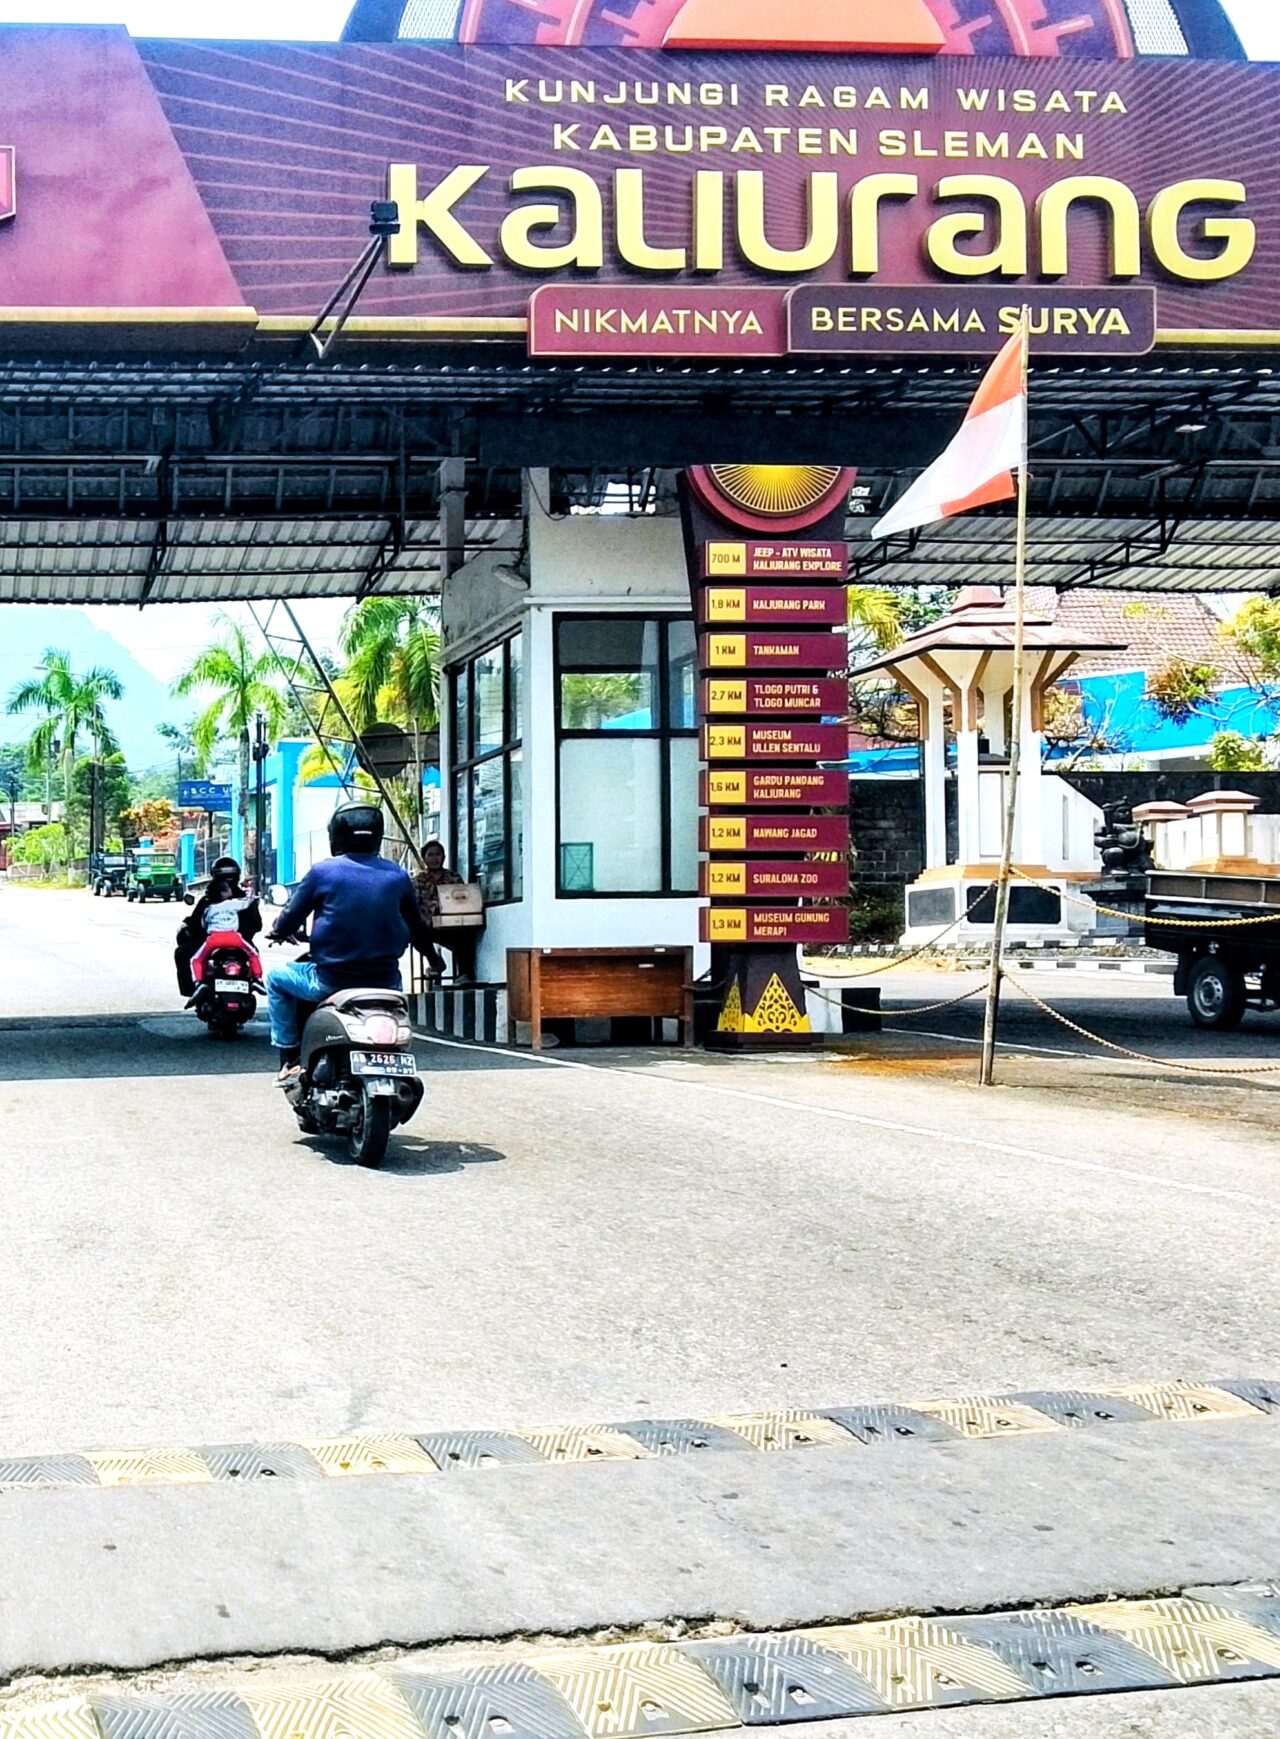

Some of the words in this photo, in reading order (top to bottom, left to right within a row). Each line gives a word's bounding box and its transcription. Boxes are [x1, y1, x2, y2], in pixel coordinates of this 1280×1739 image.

[505, 79, 738, 106] KUNJUNGI
[765, 84, 929, 110] RAGAM
[957, 88, 1128, 113] WISATA
[553, 123, 857, 154] KABUPATEN
[879, 129, 1084, 160] SLEMAN
[555, 308, 764, 335] NIKMATNYA
[811, 306, 986, 332] BERSAMA
[998, 306, 1131, 335] SURYA
[753, 547, 775, 558] JEEP
[782, 547, 798, 558] ATV
[800, 547, 832, 558] WISATA
[711, 553, 730, 564] 700
[732, 553, 740, 563] M
[753, 560, 801, 571] KALIURANG
[803, 561, 842, 571] EXPLORE
[726, 599, 740, 609] KM
[753, 600, 801, 610] KALIURANG
[802, 600, 825, 610] PARK
[715, 645, 720, 655] 1
[722, 645, 736, 655] KM
[754, 684, 783, 695] TLOGO
[784, 684, 811, 695] PUTRI
[728, 690, 742, 700] KM
[754, 698, 783, 708] TLOGO
[784, 698, 821, 708] MUNCAR
[752, 730, 792, 740] MUSEUM
[727, 736, 741, 746] KM
[752, 743, 780, 753] ULLEN
[782, 743, 821, 753] SENTALU
[753, 775, 783, 785] GARDU
[784, 776, 824, 786] PANDANG
[725, 782, 740, 792] KM
[753, 788, 801, 799] KALIURANG
[726, 827, 741, 837] KM
[753, 828, 789, 838] NAWANG
[791, 828, 818, 838] JAGAD
[726, 873, 740, 883] KM
[753, 873, 798, 883] SURALOKA
[800, 873, 819, 883] ZOO
[753, 912, 793, 923] MUSEUM
[794, 912, 830, 923] GUNUNG
[727, 919, 741, 929] KM
[753, 926, 787, 936] MERAPI
